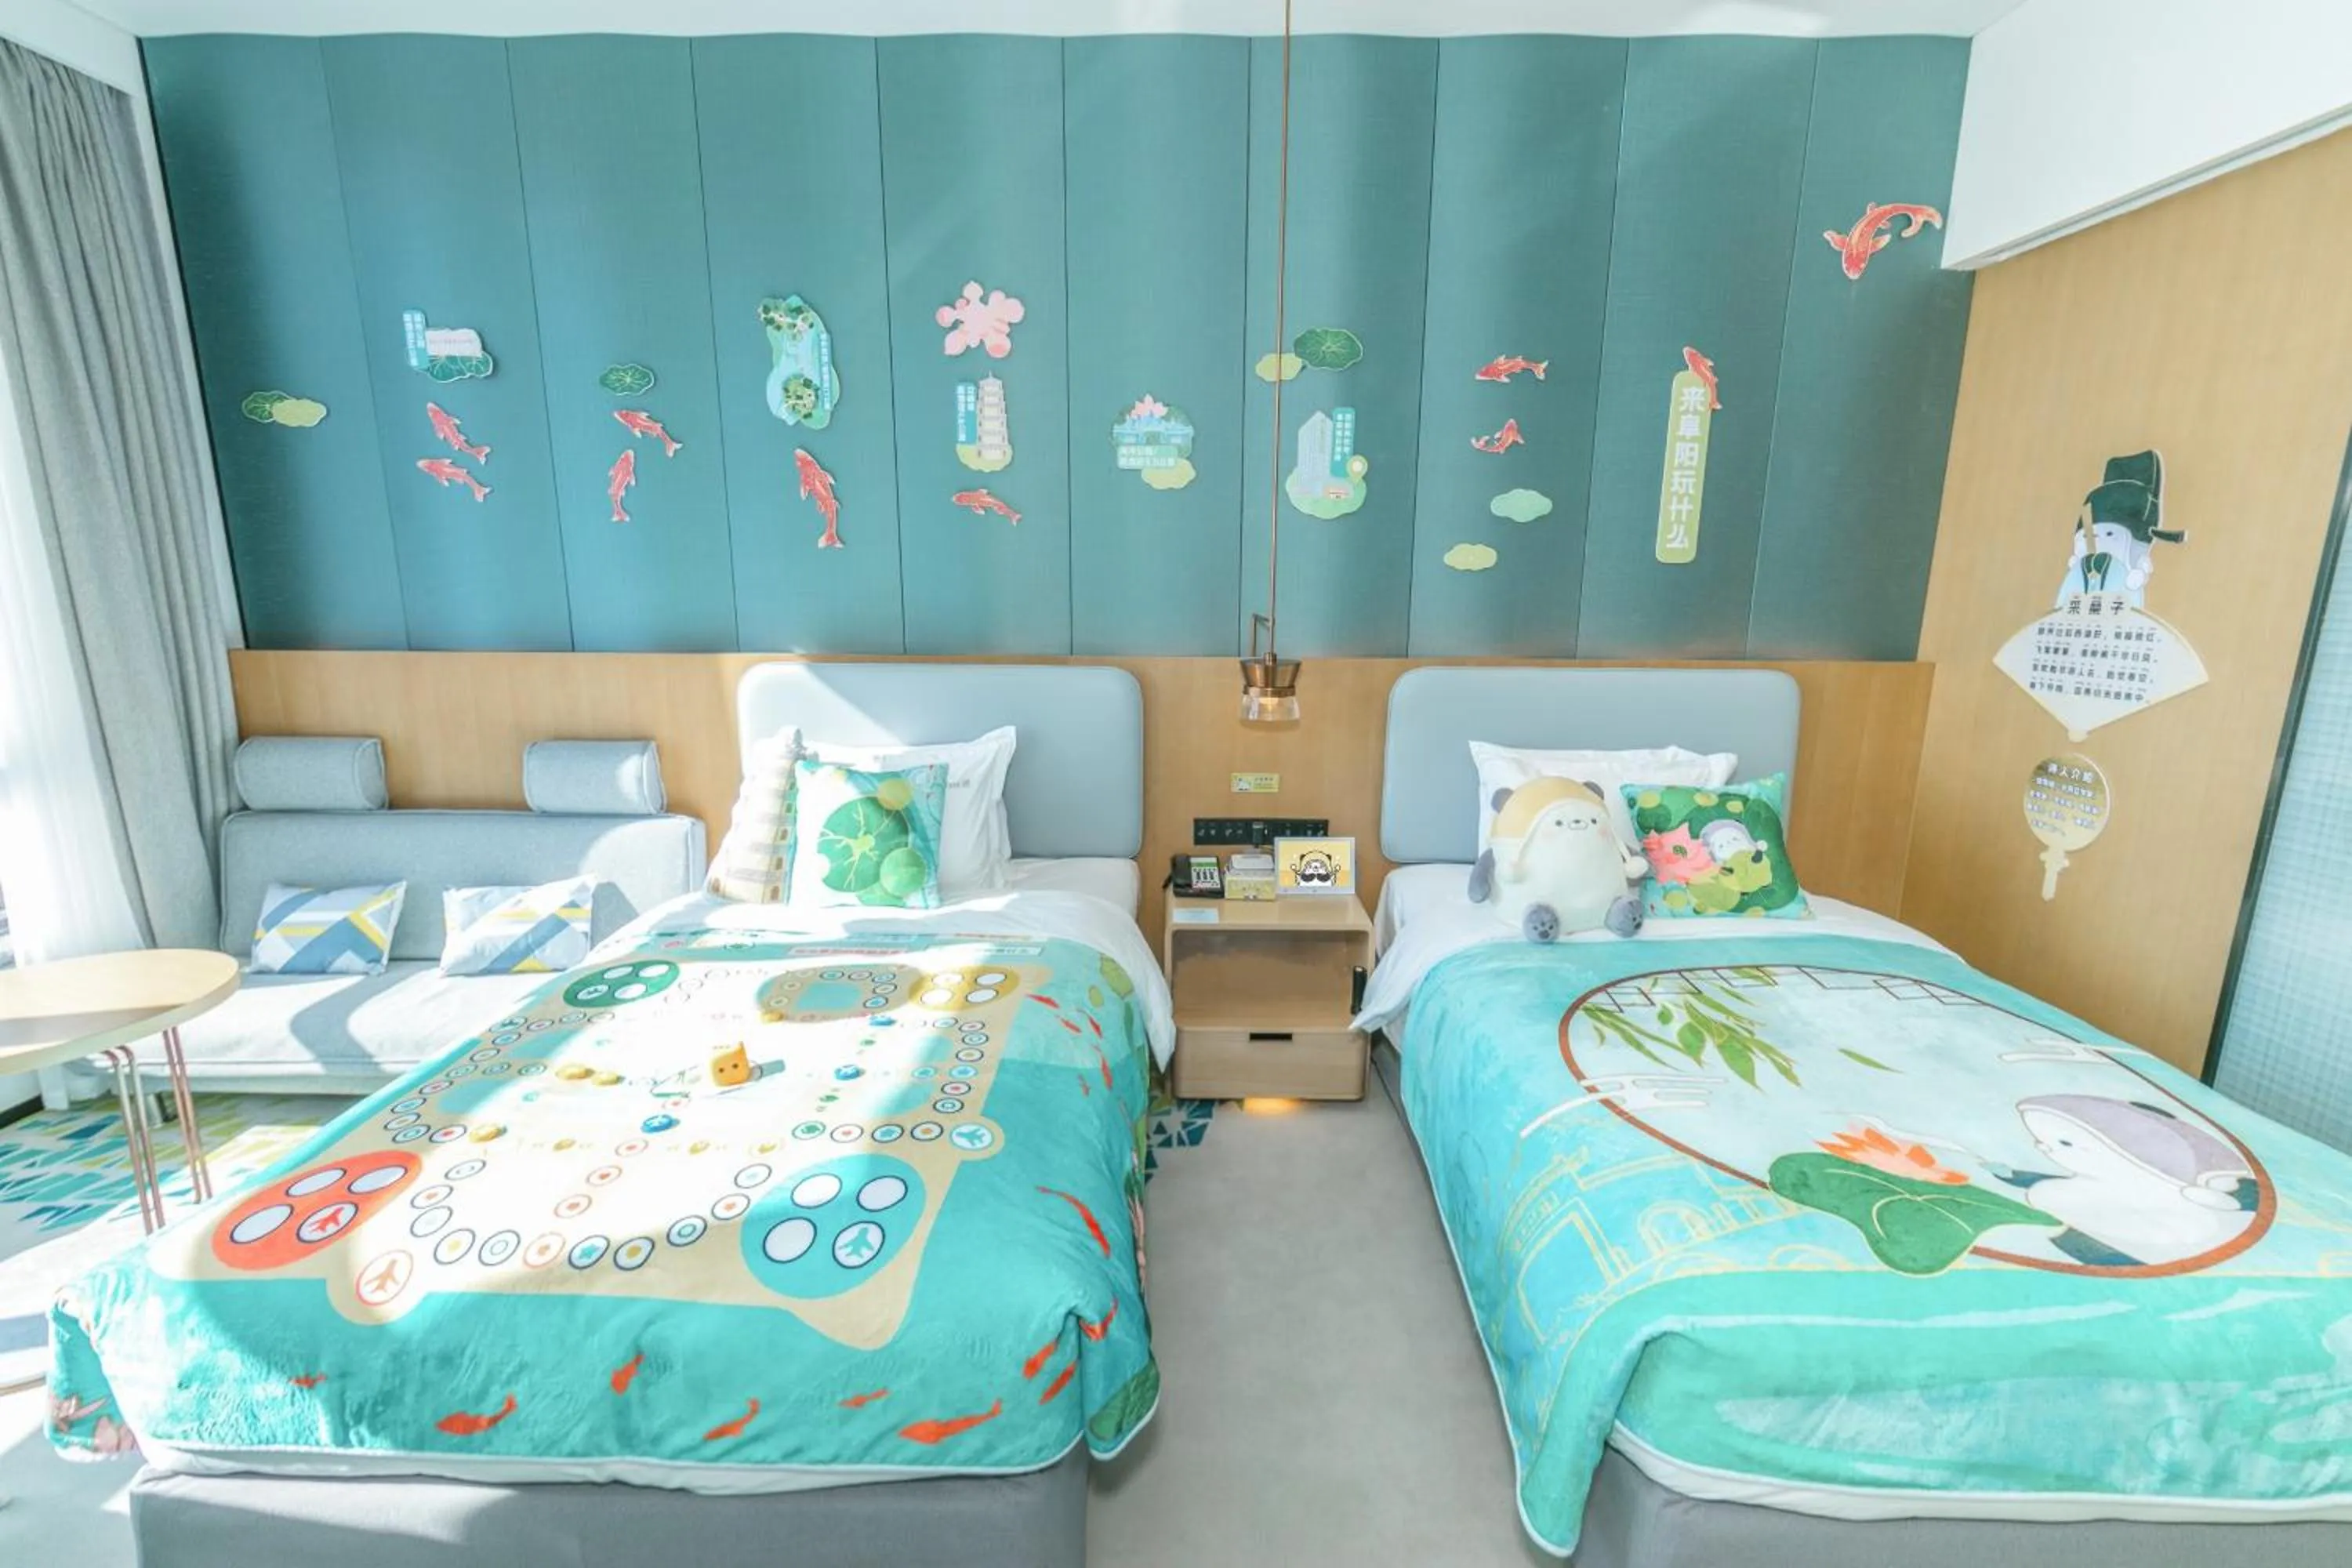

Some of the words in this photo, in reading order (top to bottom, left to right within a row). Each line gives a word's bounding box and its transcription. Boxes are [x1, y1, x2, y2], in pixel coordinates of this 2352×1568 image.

[1666, 387, 1705, 548] 来阜阳玩什么
